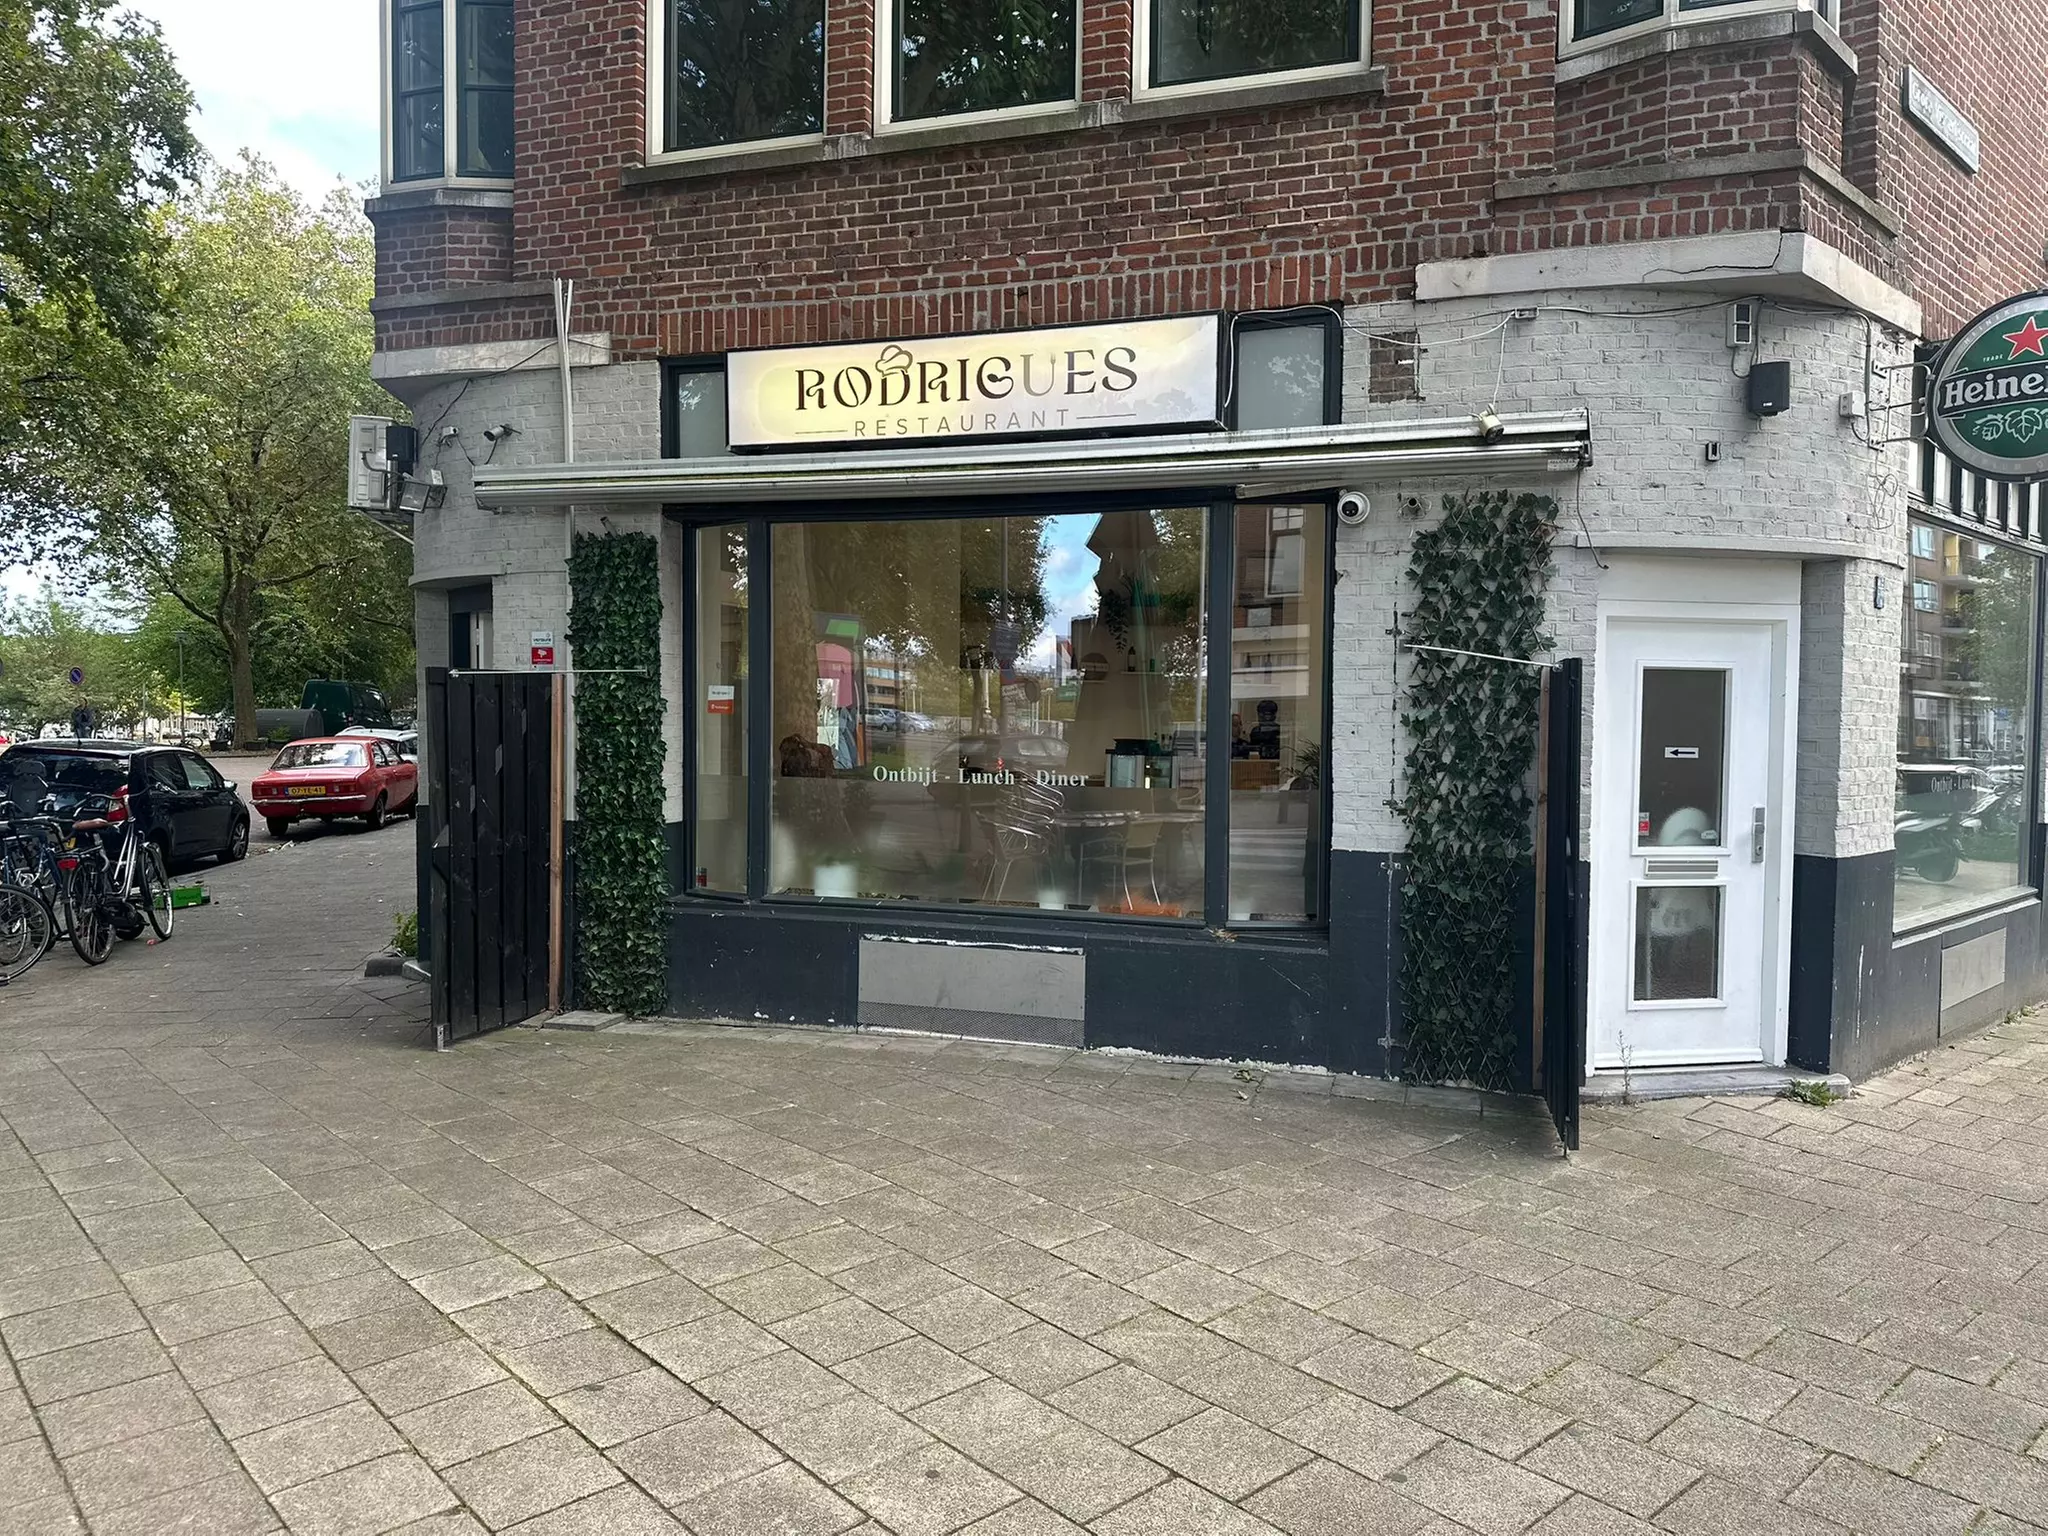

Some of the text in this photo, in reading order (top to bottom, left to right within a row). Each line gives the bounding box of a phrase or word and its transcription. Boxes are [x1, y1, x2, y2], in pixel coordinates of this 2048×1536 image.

[794, 344, 1139, 411] RODRIGUES
[1943, 363, 2048, 409] Heine
[853, 408, 1071, 438] RESTAURANT
[872, 765, 939, 787] Ontbijt
[958, 768, 1015, 786] Lunch
[1036, 770, 1090, 787] Diner
